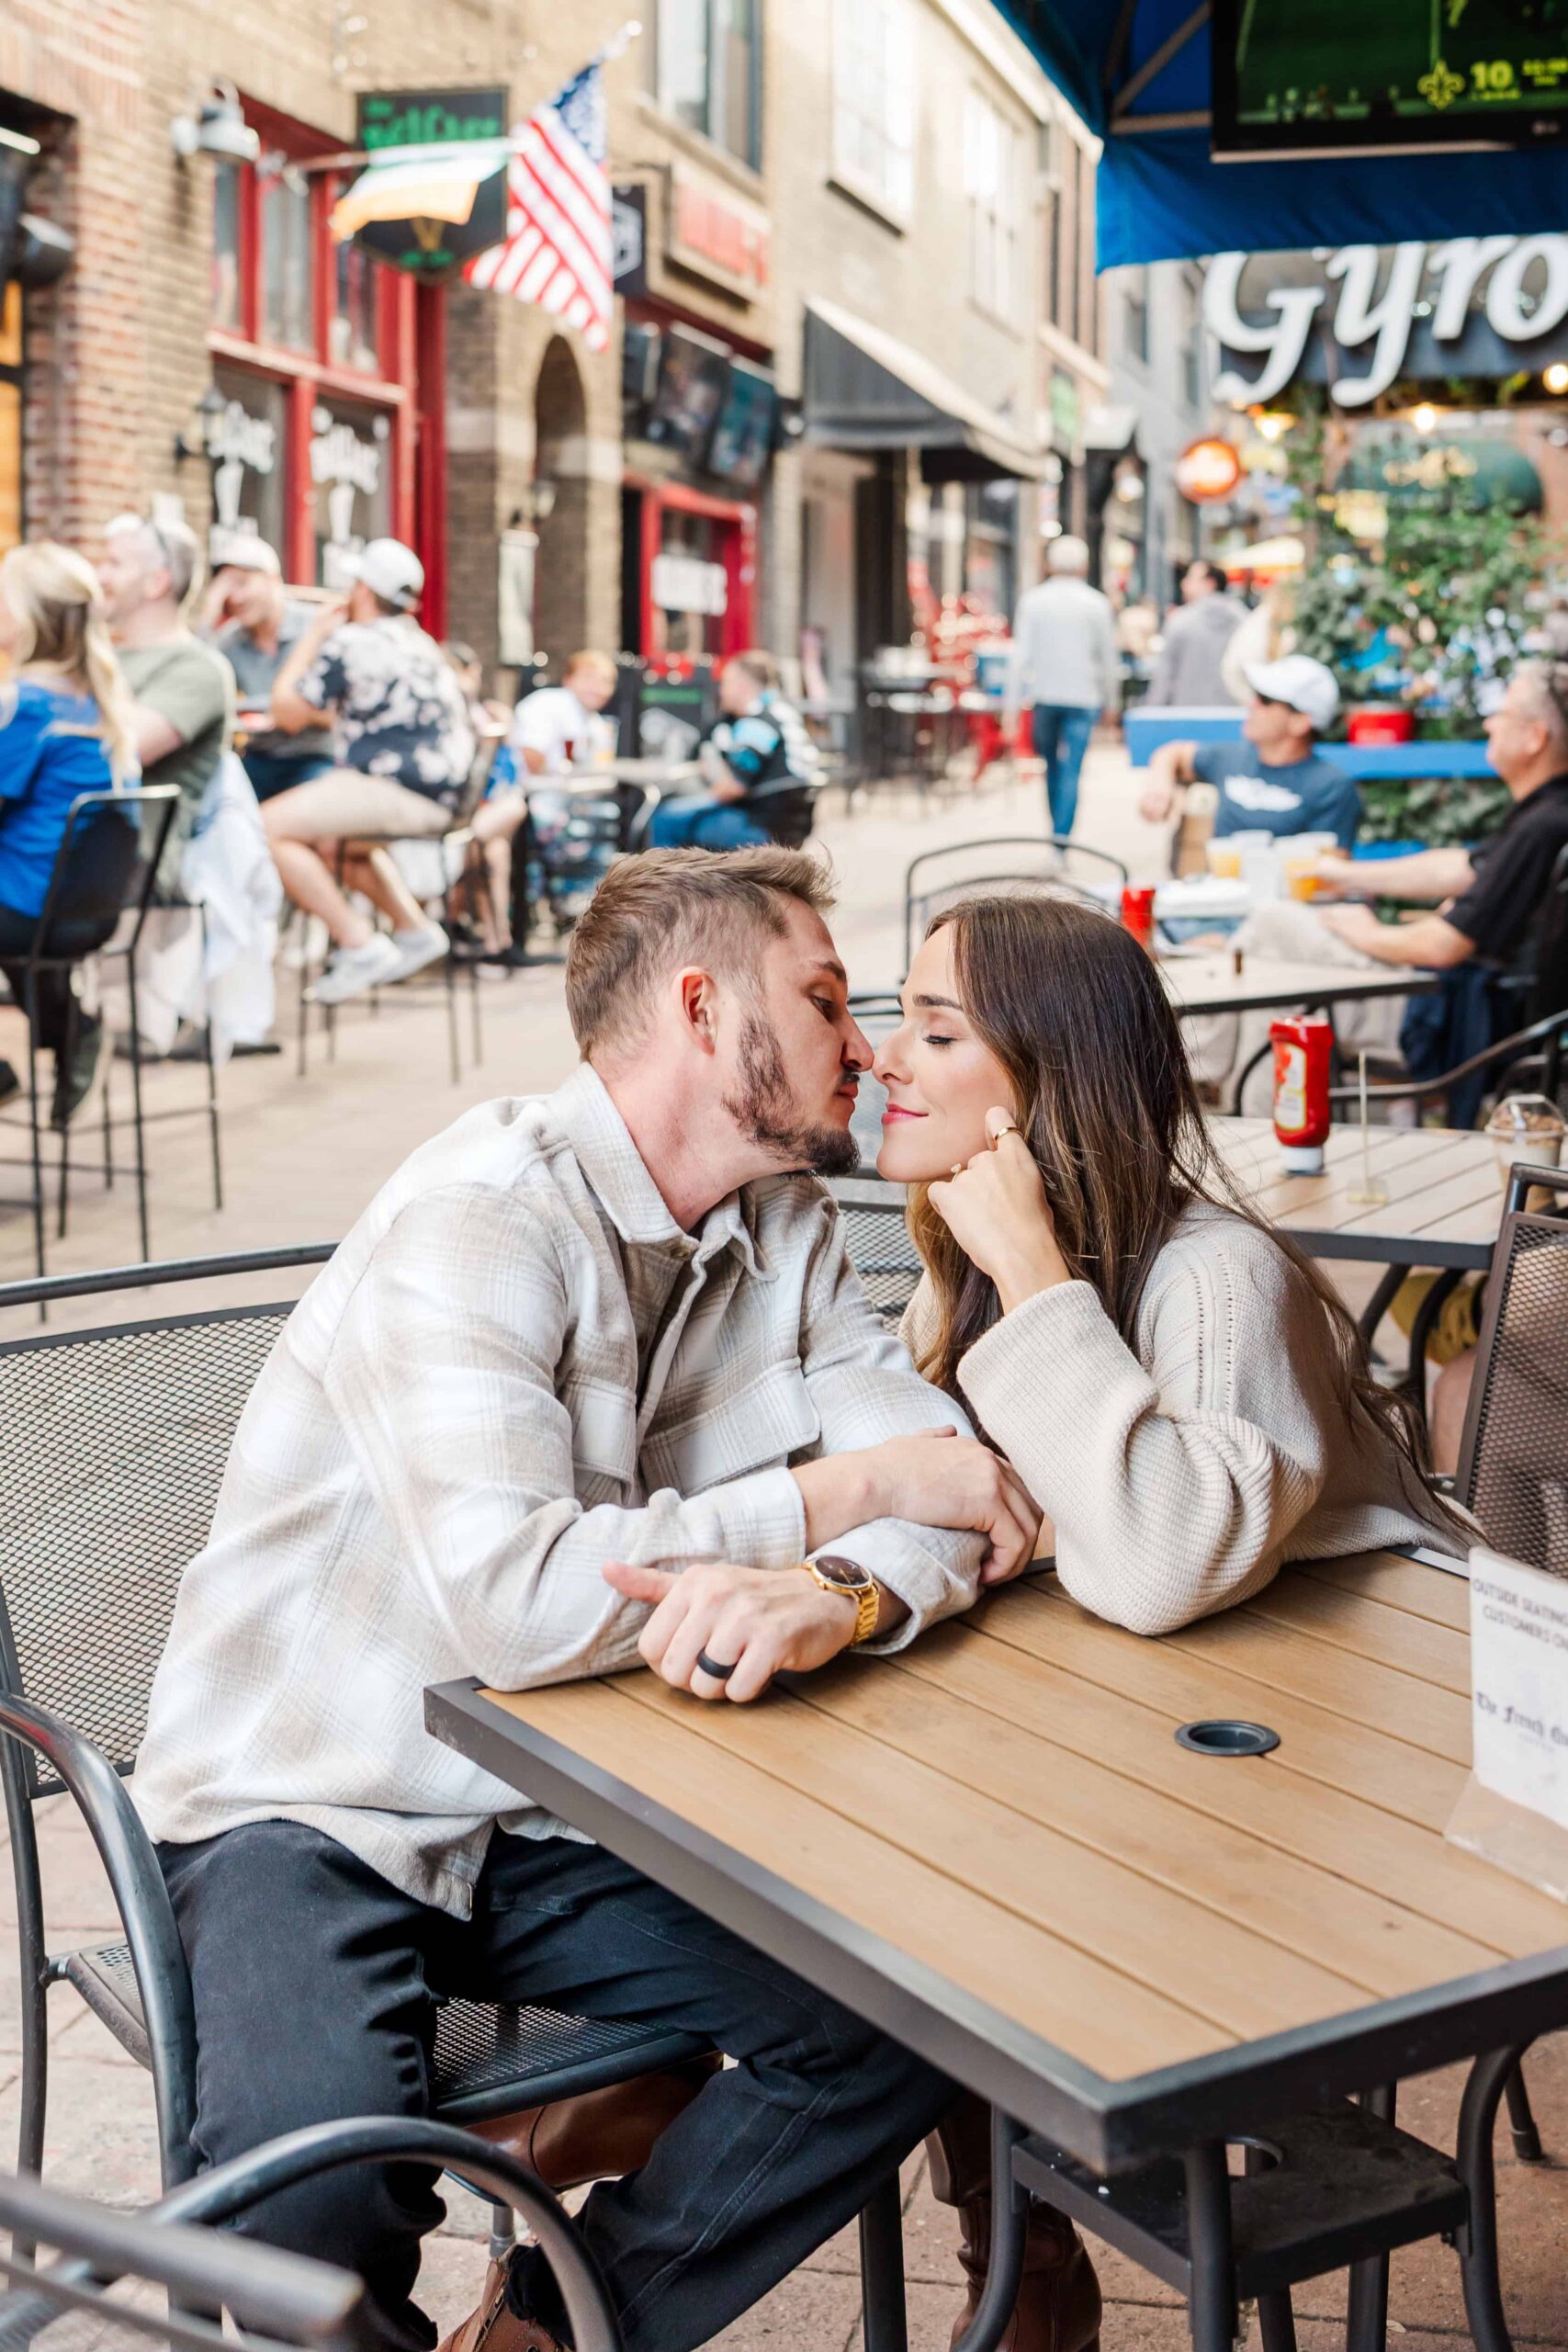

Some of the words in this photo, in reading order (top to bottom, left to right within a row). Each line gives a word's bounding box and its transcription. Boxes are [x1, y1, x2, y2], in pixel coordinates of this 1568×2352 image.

[1471, 60, 1513, 89] 10
[1202, 233, 1568, 407] Gyro
[1472, 1578, 1517, 1608] OUTSIDE
[1483, 1605, 1550, 1644] CUSTOMERS
